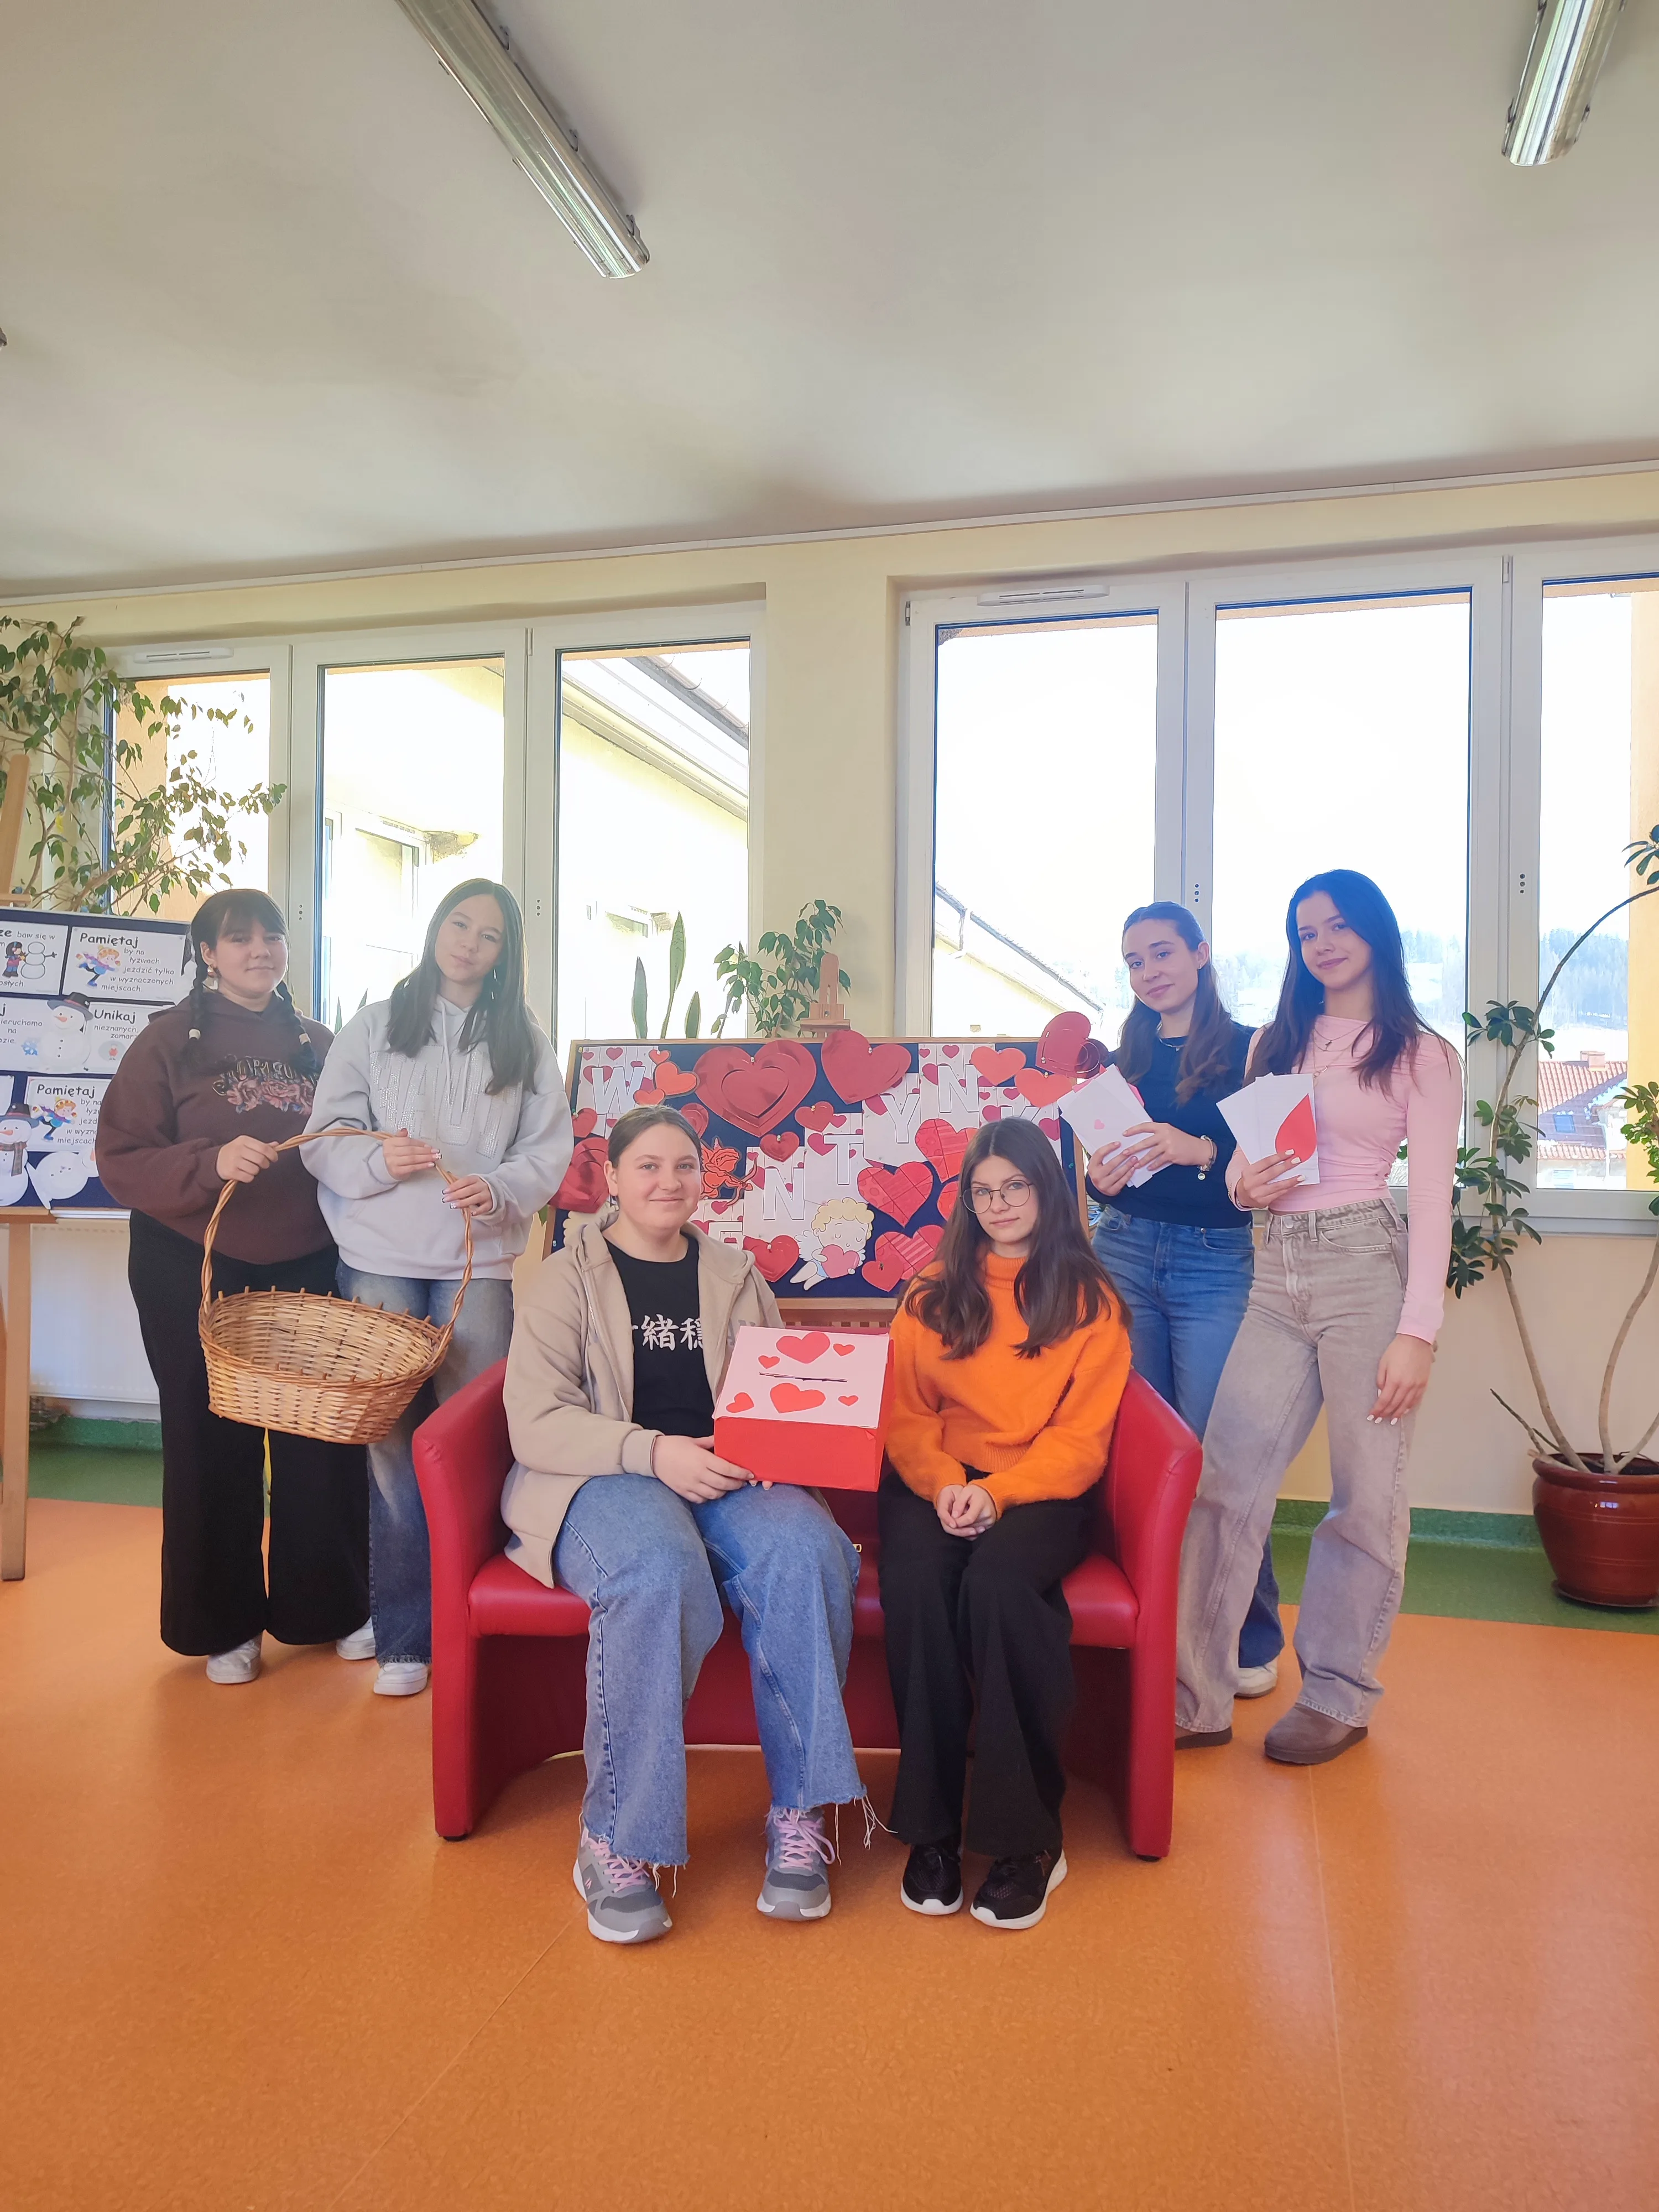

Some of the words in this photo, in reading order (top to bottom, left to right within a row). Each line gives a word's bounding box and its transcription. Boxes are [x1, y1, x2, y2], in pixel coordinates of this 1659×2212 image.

[80, 932, 139, 949] Pamiętaj
[124, 947, 134, 956] by
[118, 977, 174, 985] wyznaczonych
[94, 1009, 136, 1024] Unikaj
[36, 1084, 96, 1099] Pamiętaj
[81, 1098, 91, 1107] by
